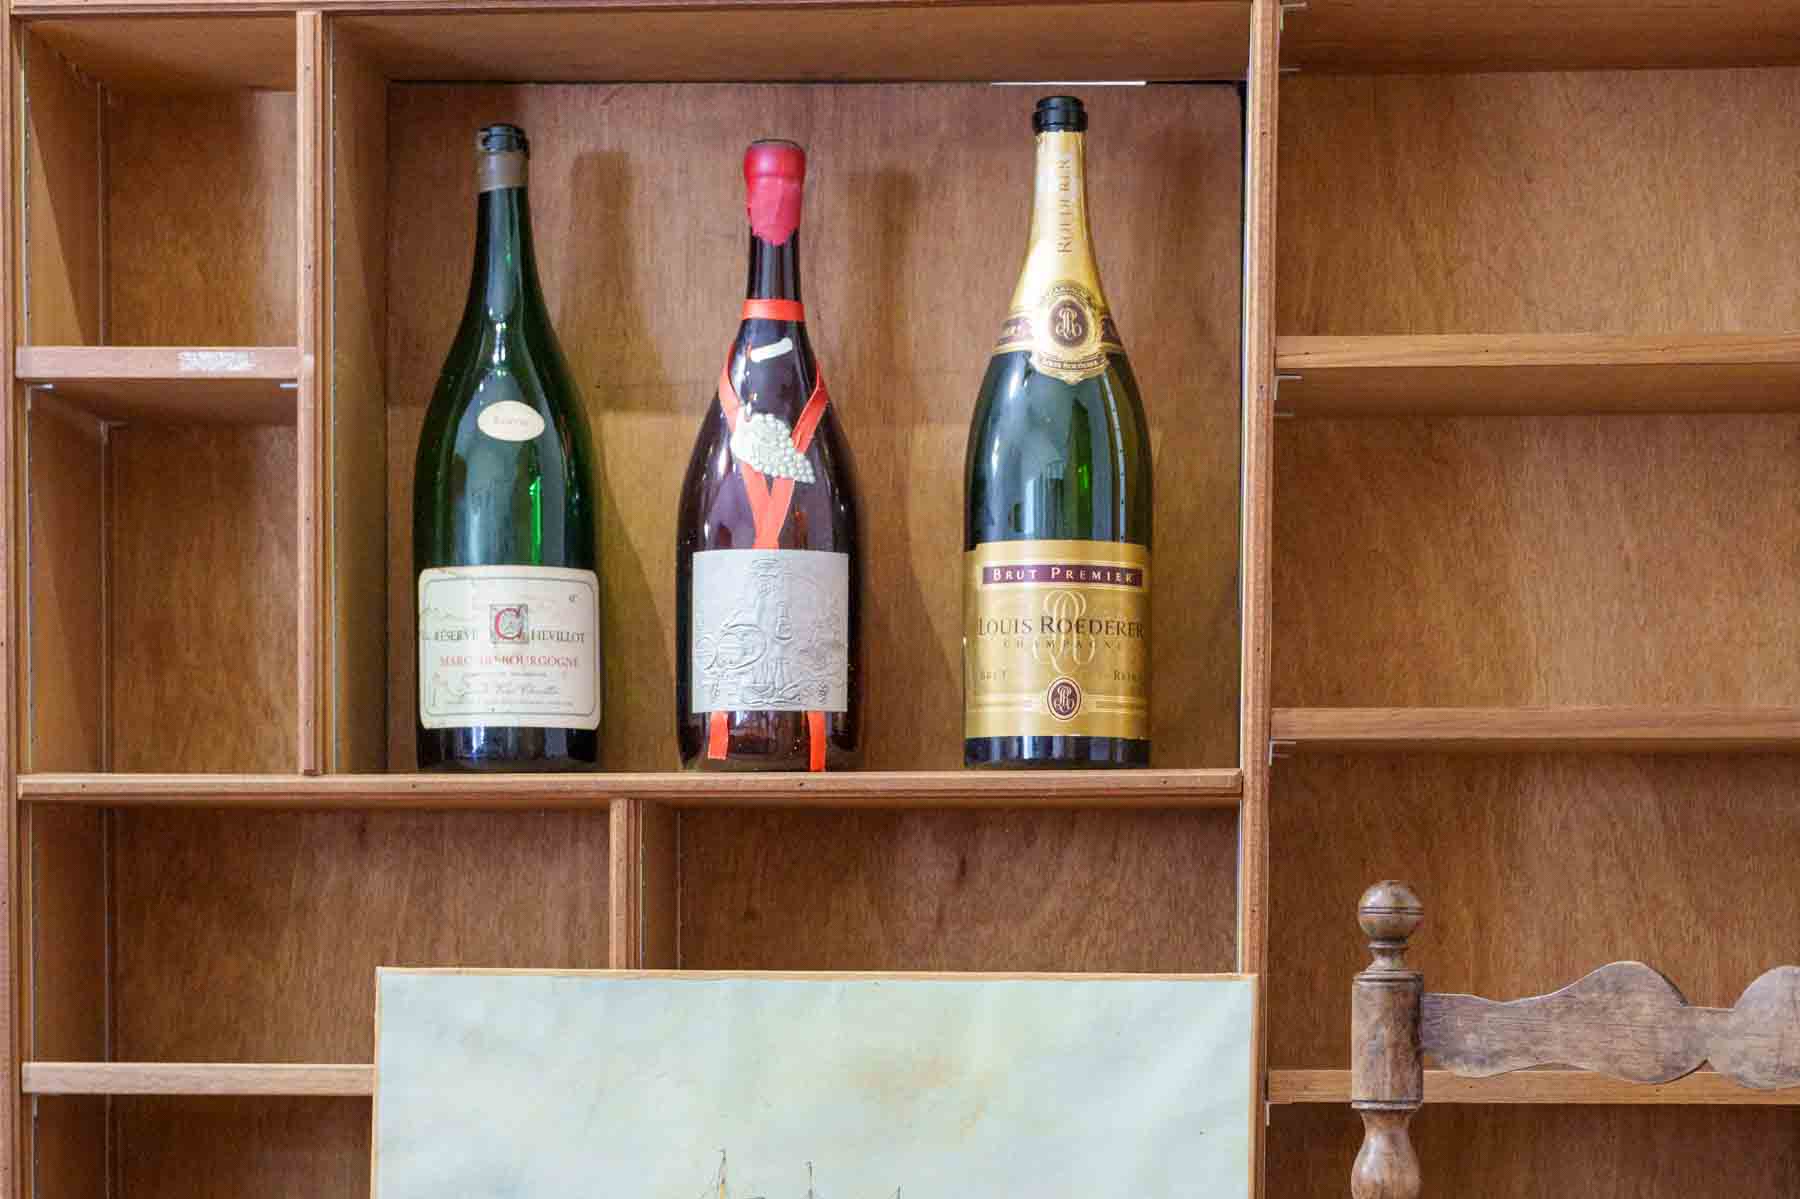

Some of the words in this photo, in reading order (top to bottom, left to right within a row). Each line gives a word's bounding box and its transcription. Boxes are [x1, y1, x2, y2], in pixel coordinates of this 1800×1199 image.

[993, 568, 1038, 581] BRUT
[1051, 567, 1133, 583] PREMIER
[978, 616, 1033, 636] LOUIS
[1040, 615, 1144, 639] ROEDERER
